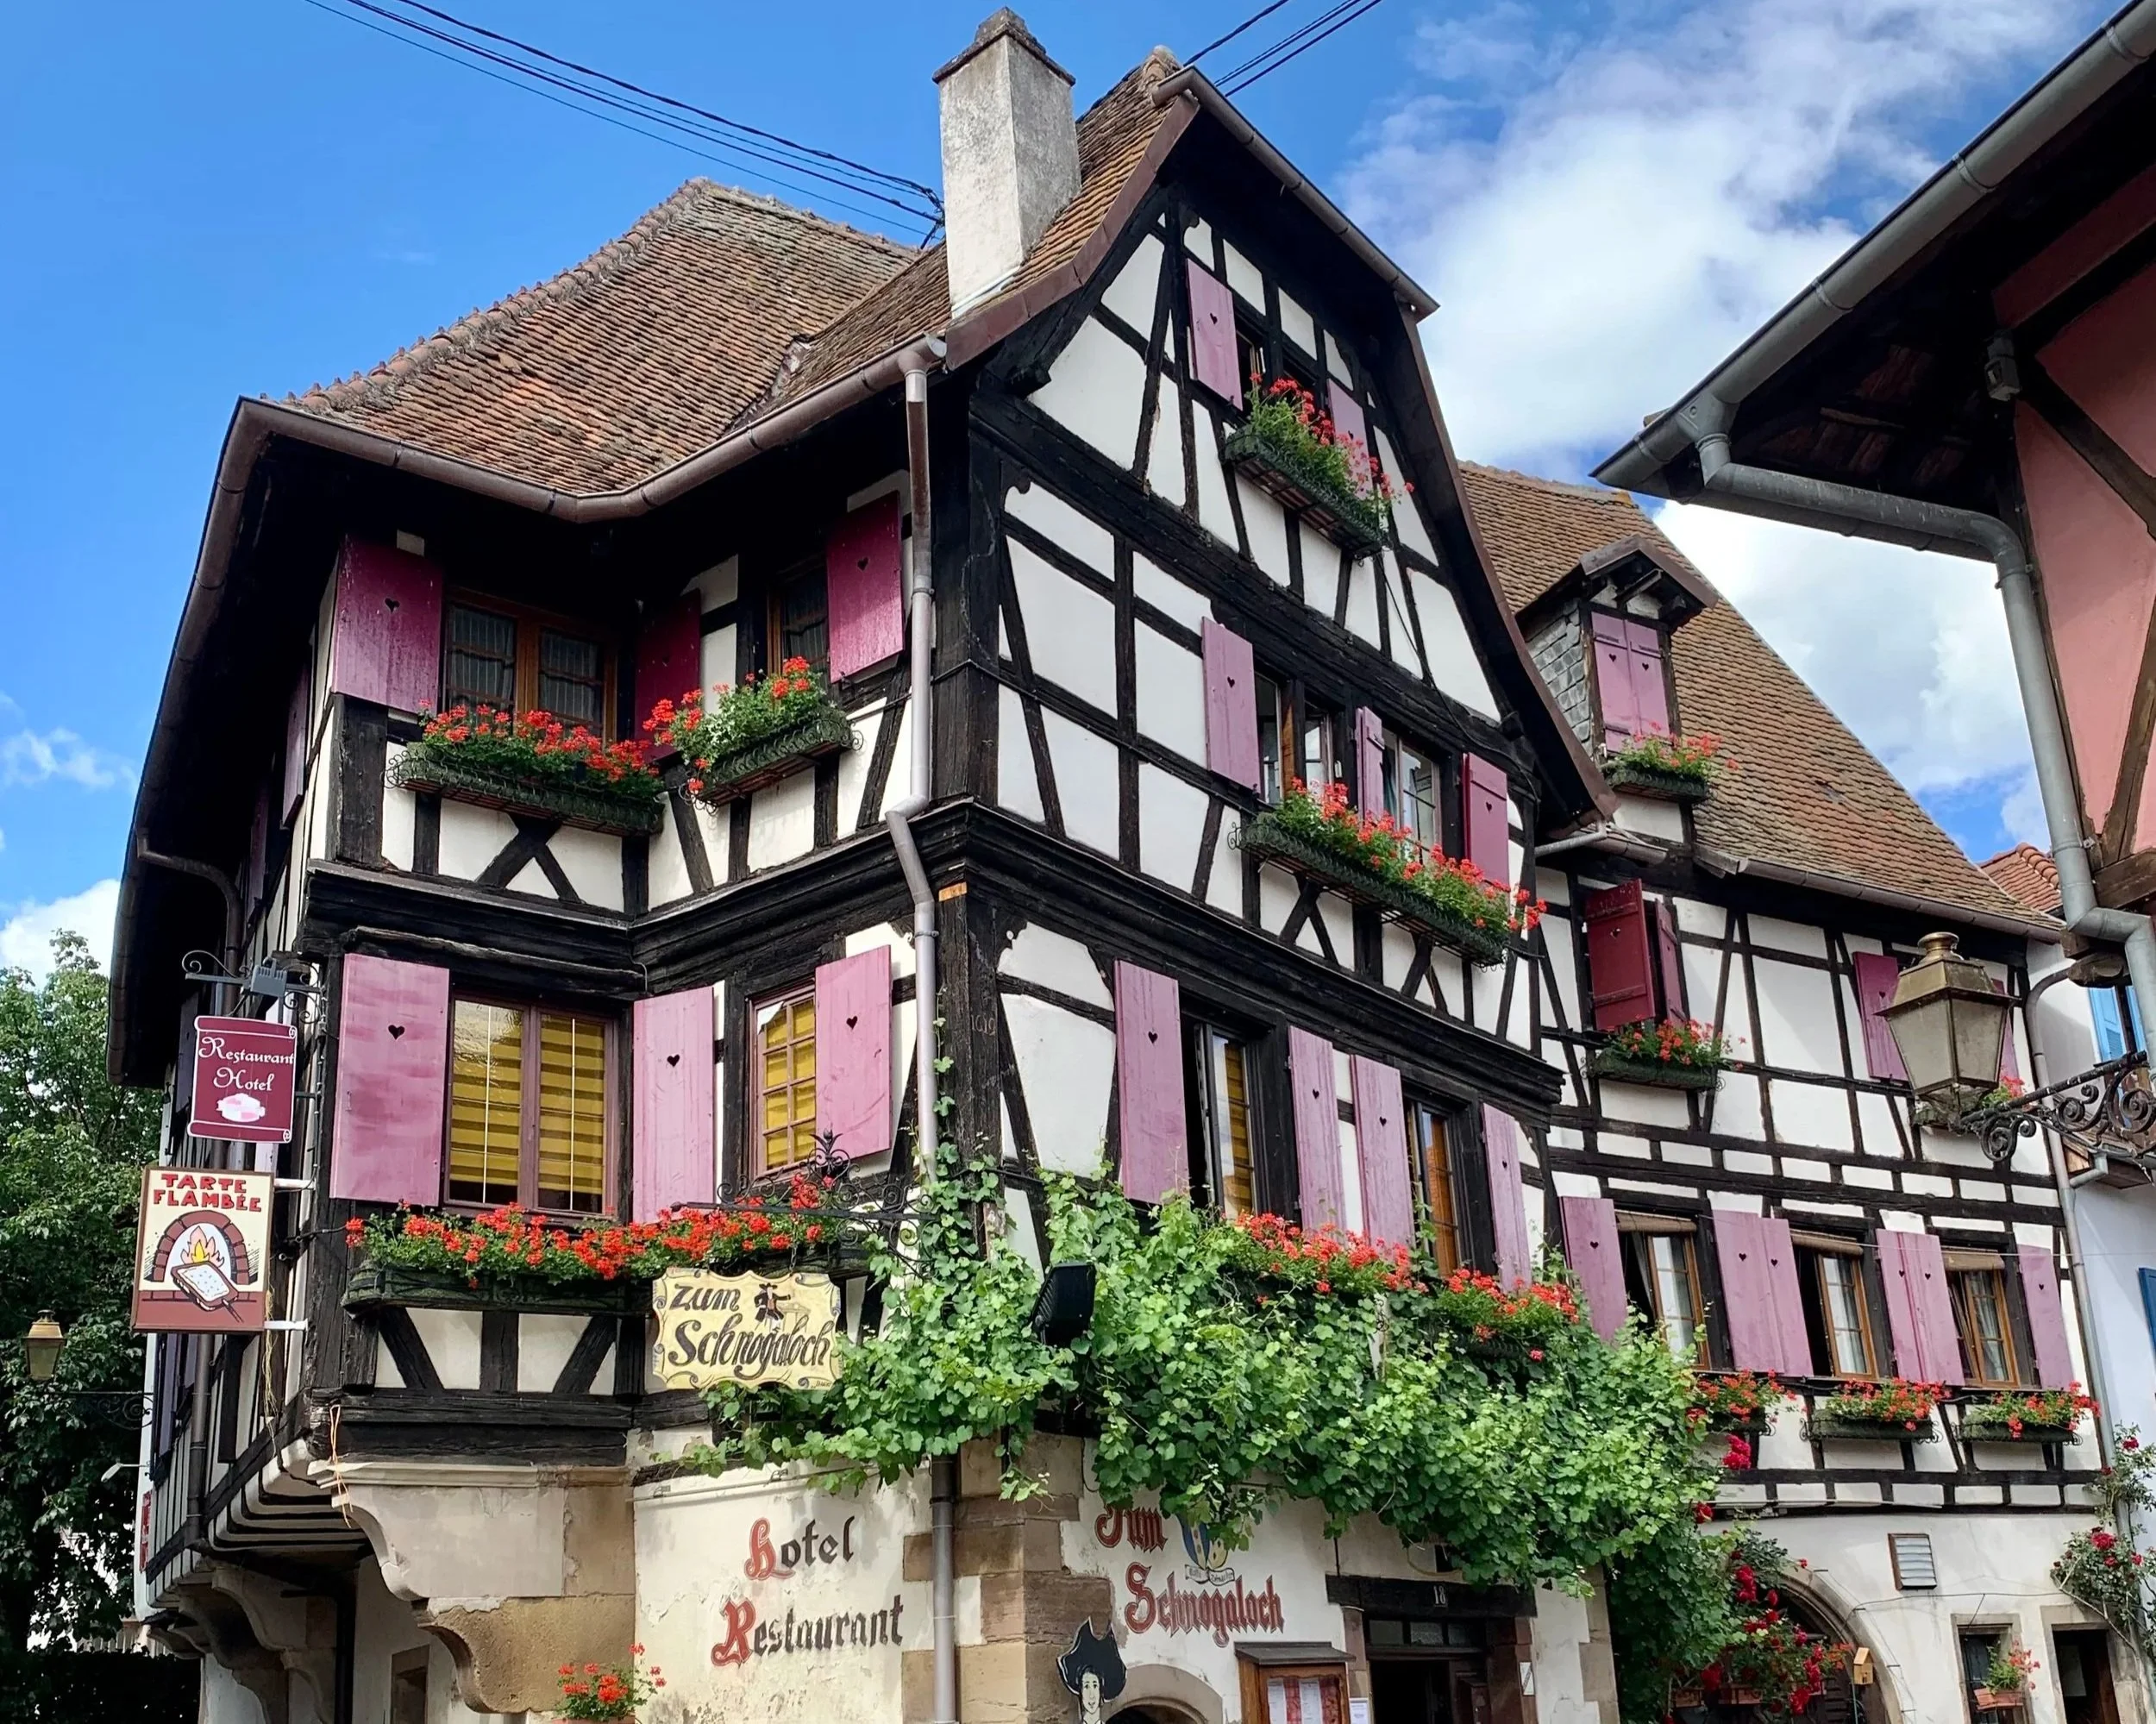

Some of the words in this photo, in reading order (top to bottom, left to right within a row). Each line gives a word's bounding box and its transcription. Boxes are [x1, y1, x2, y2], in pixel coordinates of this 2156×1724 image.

[198, 1037, 295, 1064] Restaurant
[213, 1067, 275, 1091] Hotel
[161, 1173, 247, 1194] TARTE
[153, 1189, 261, 1213] FLAMBÉE
[1433, 1585, 1446, 1605] 18
[710, 1594, 904, 1668] Restaurant
